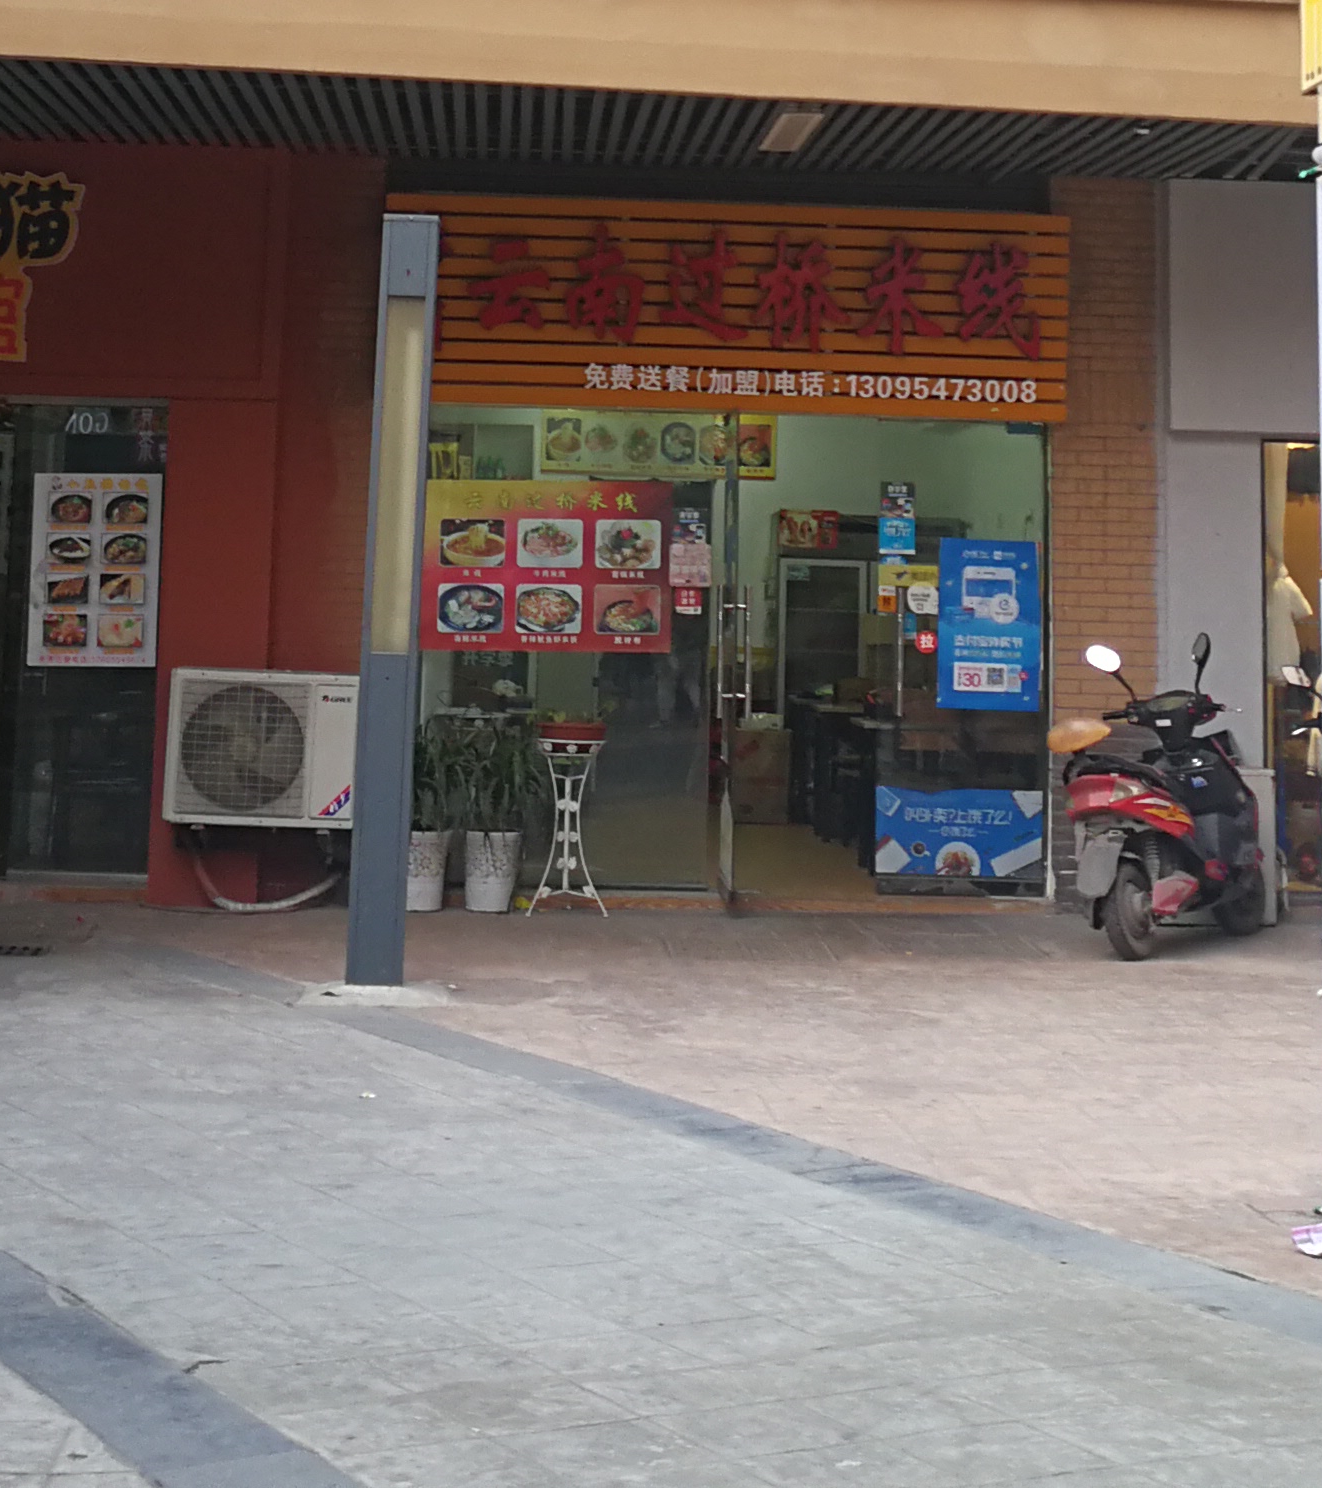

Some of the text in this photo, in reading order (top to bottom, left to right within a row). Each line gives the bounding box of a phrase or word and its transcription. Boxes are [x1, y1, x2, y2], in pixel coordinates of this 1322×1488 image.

[435, 223, 1042, 361] 云南过桥米线
